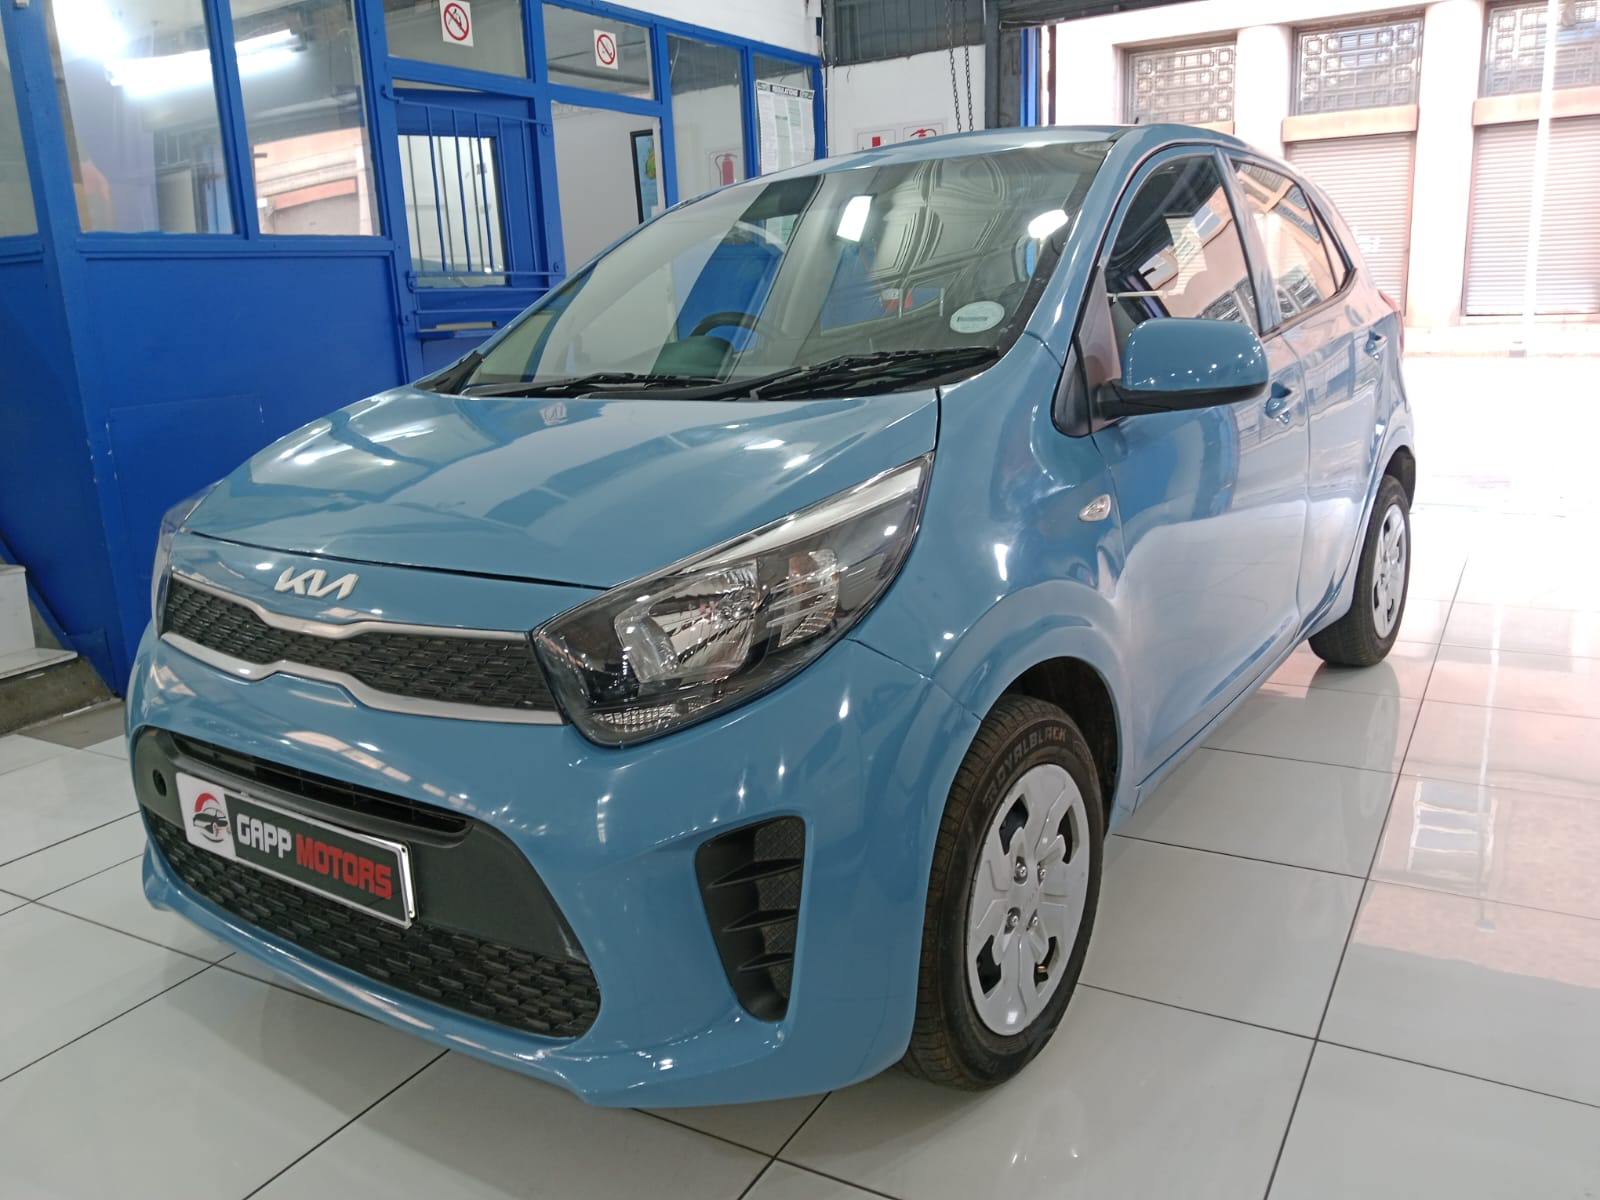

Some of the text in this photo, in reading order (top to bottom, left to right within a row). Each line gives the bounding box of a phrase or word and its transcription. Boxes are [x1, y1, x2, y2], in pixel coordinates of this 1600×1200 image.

[274, 566, 359, 600] KIA
[236, 813, 392, 899] GAPP MOTORS
